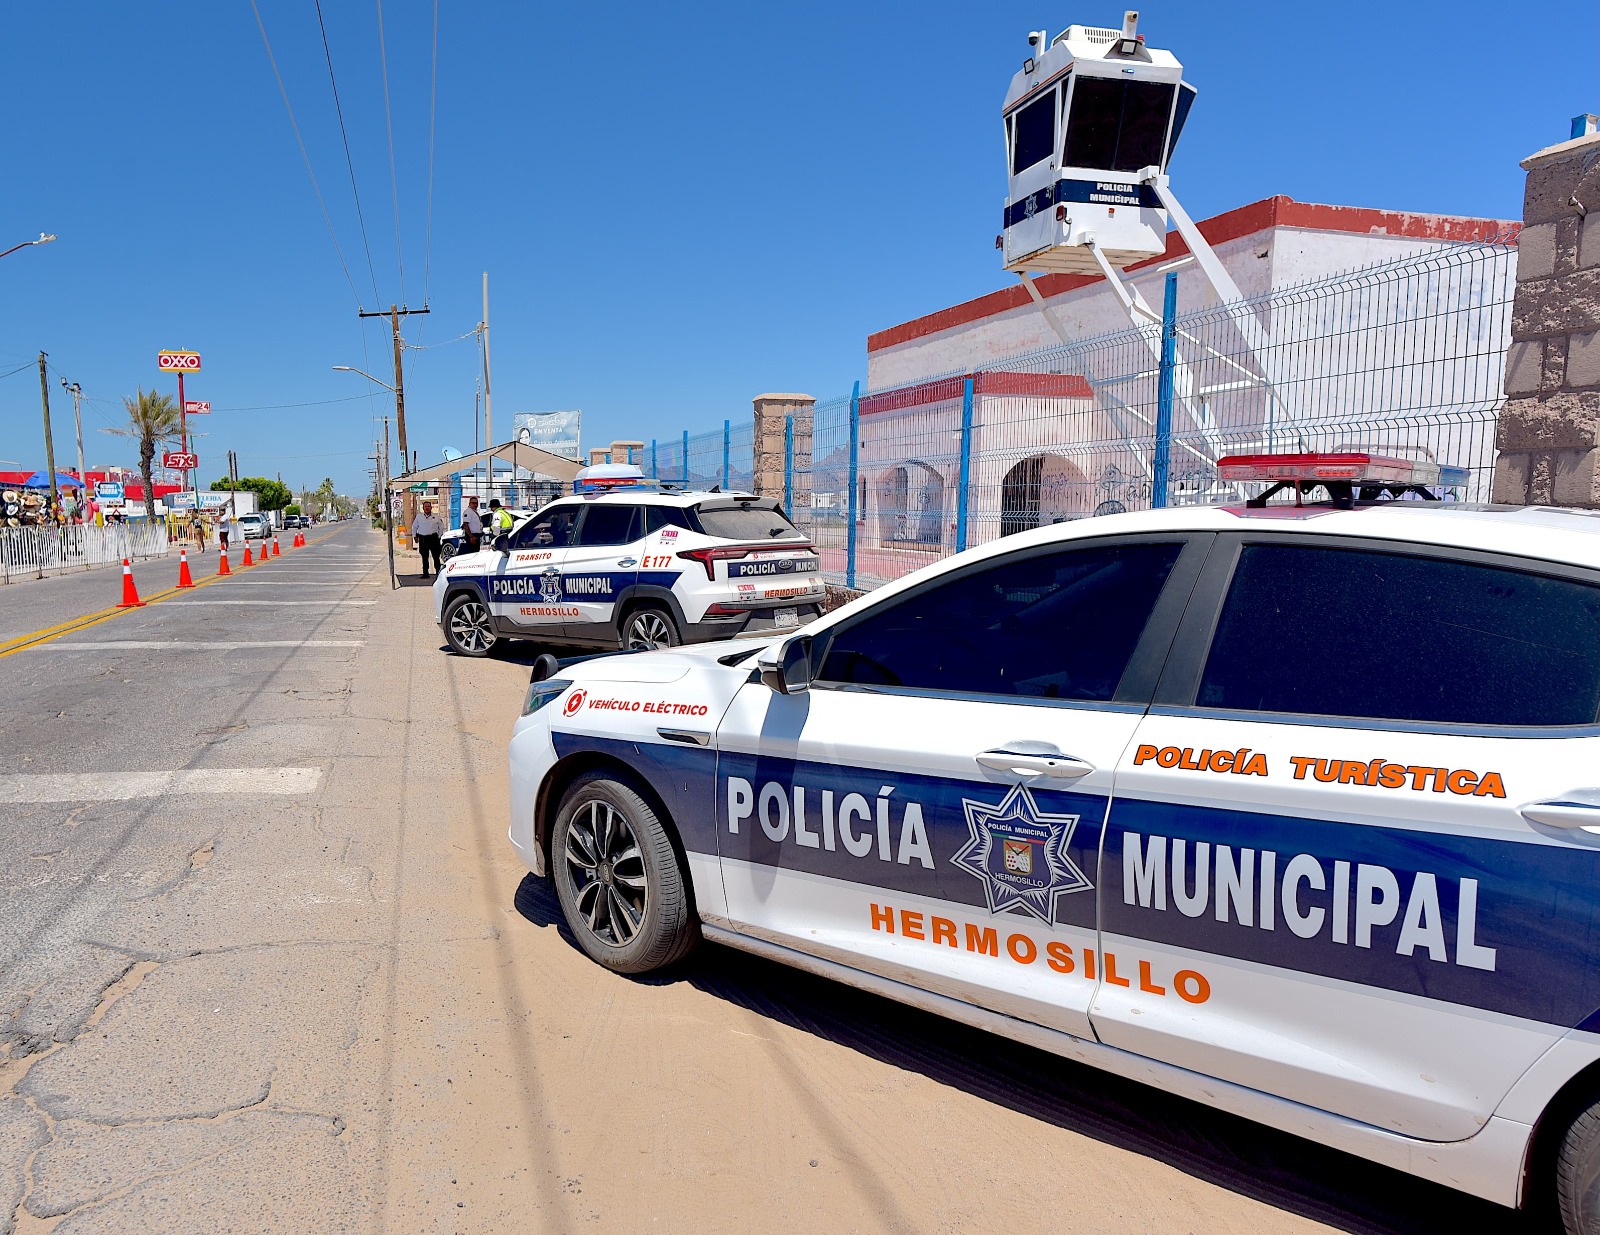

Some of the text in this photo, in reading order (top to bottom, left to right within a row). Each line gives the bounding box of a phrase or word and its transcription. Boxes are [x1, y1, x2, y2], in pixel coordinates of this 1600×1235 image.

[1097, 183, 1133, 193] POLICIA
[1090, 193, 1140, 205] MUNICIPAL
[160, 355, 199, 367] OXXO
[516, 552, 552, 561] TRANSITO
[642, 556, 672, 568] E 177
[740, 563, 776, 575] POLICÍA
[493, 577, 613, 595] POLICÍA MUNICIPAL
[764, 587, 808, 598] HERMOSILLO
[520, 607, 579, 616] HERMOSILLO
[588, 698, 708, 716] VEHÍCULO ELÉCTRICO
[1134, 744, 1508, 798] POLICÍA TURÍSTICA
[988, 822, 1049, 838] POLICÍA MUNICIPAL
[727, 776, 1497, 972] POLICÍA MUNICIPAL
[995, 872, 1044, 888] HERMOSILLO
[870, 903, 1211, 1004] HERMOSILLO
